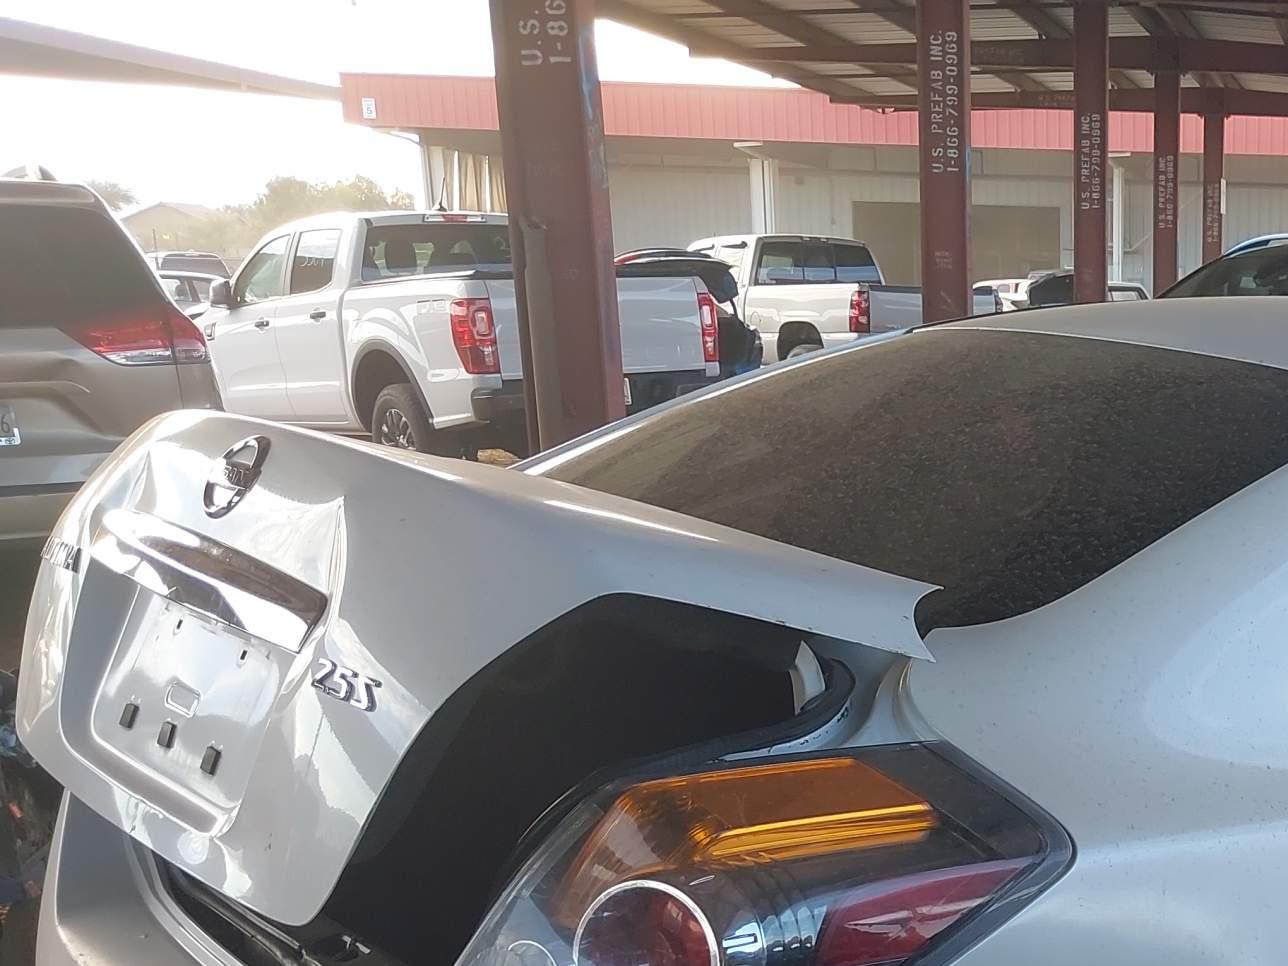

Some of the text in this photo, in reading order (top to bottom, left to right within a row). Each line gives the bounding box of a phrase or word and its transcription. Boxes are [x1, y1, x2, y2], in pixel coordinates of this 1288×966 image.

[519, 9, 543, 66] U.S.
[929, 30, 944, 173] U.S. PREFAB INC.
[945, 31, 960, 172] 1-866-799-0969
